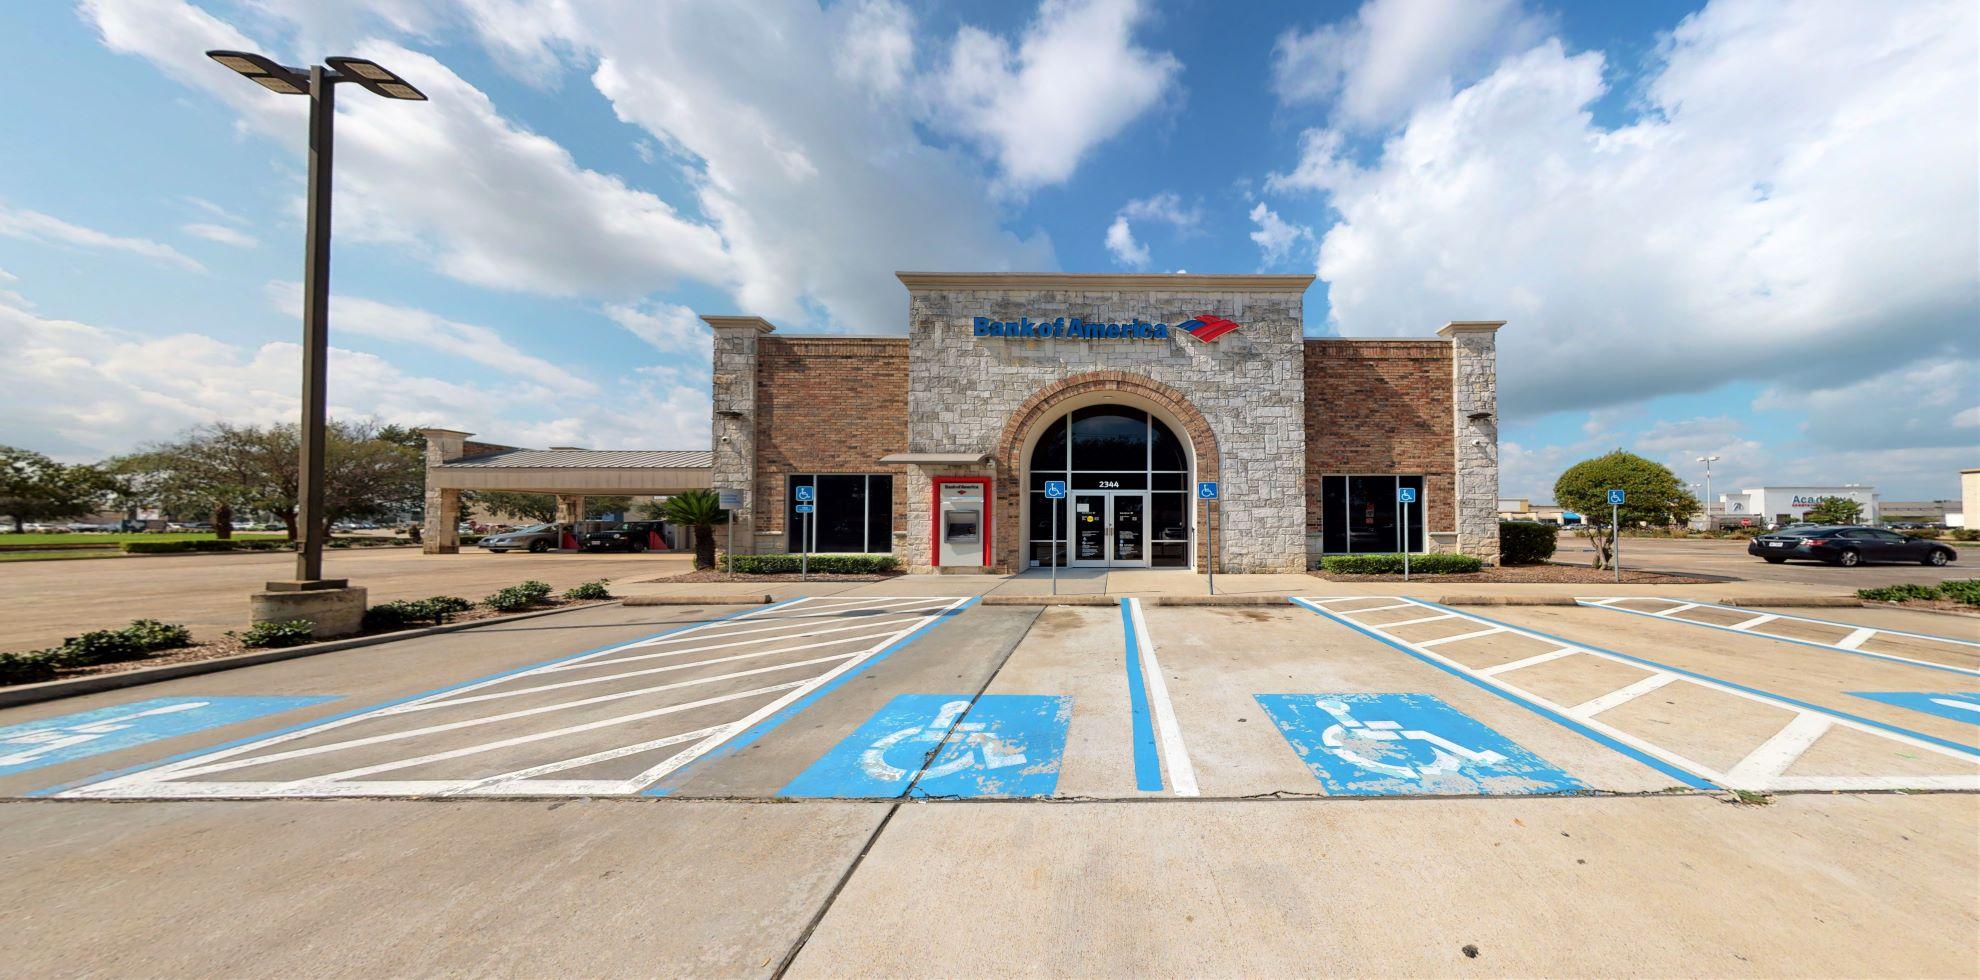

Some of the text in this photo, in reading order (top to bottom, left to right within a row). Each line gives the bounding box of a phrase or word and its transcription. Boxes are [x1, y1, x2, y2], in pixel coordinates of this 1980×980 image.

[973, 316, 1169, 339] Bank of America
[1792, 495, 1846, 504] Acady
